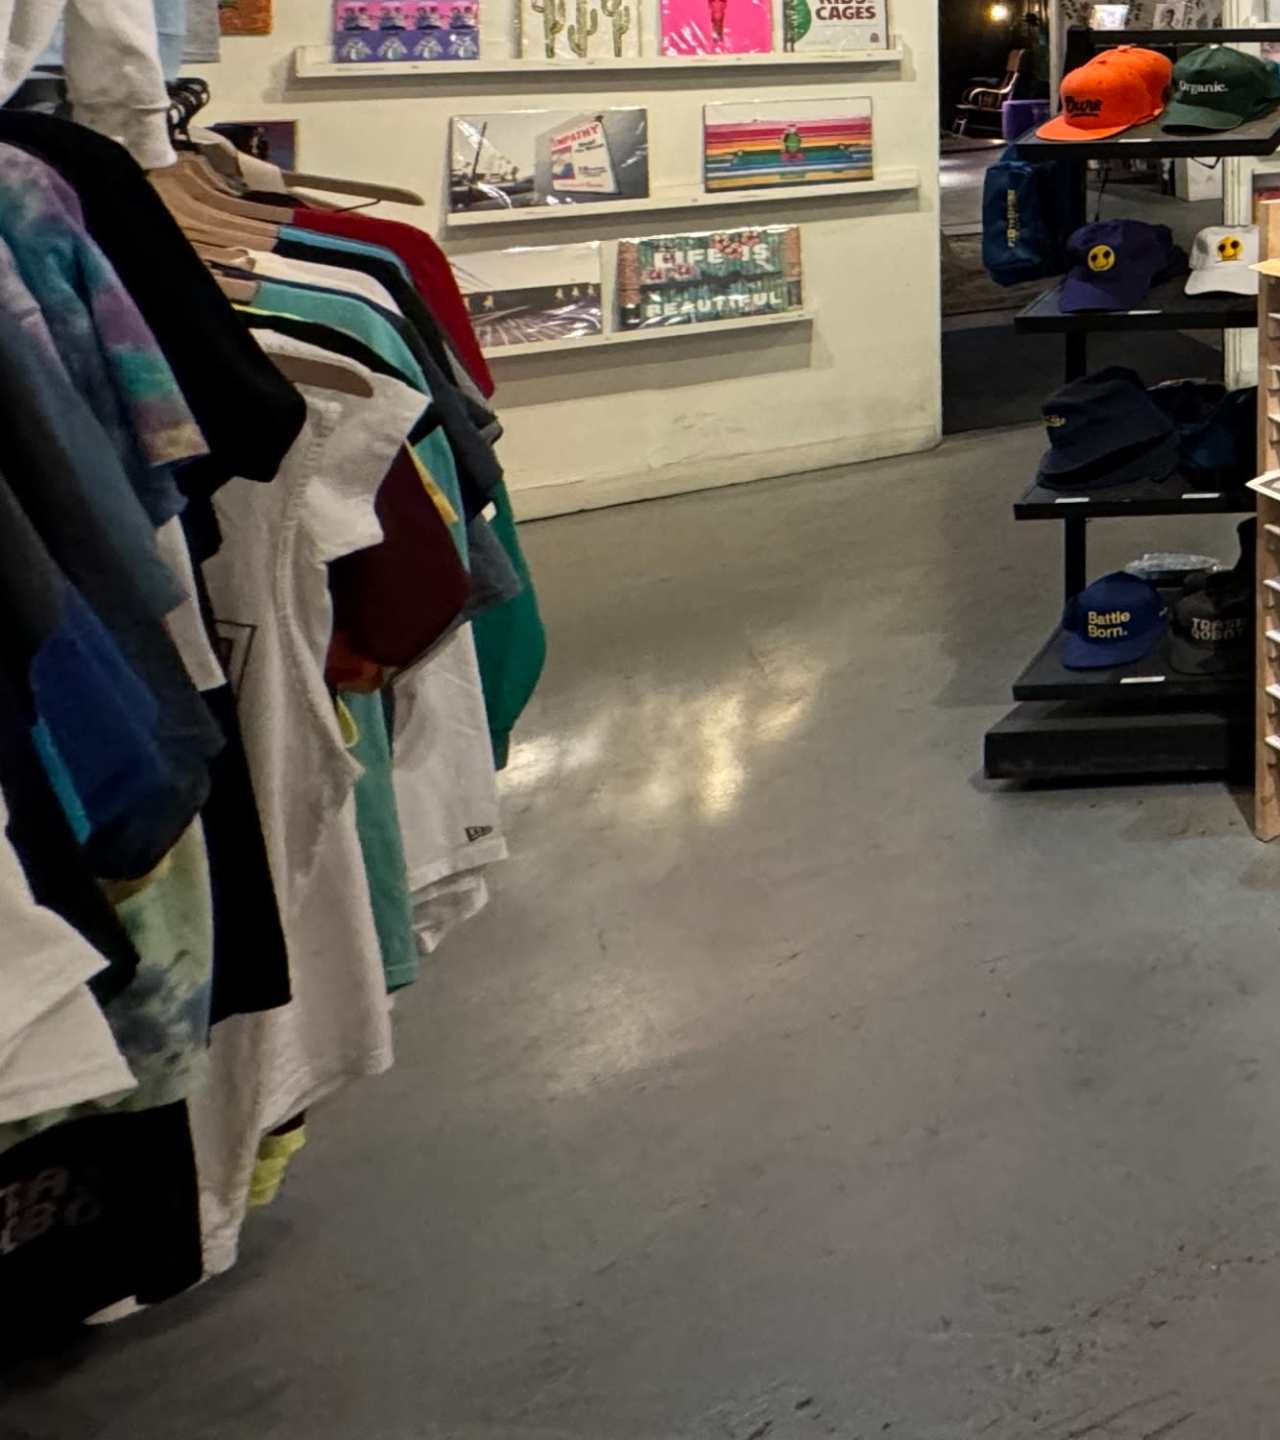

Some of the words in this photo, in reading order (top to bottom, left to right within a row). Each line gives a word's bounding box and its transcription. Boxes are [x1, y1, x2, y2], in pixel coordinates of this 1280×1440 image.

[815, 5, 877, 21] CAGES
[1178, 80, 1229, 96] Organic.
[1087, 610, 1131, 626] Battle
[1087, 624, 1129, 639] Born.
